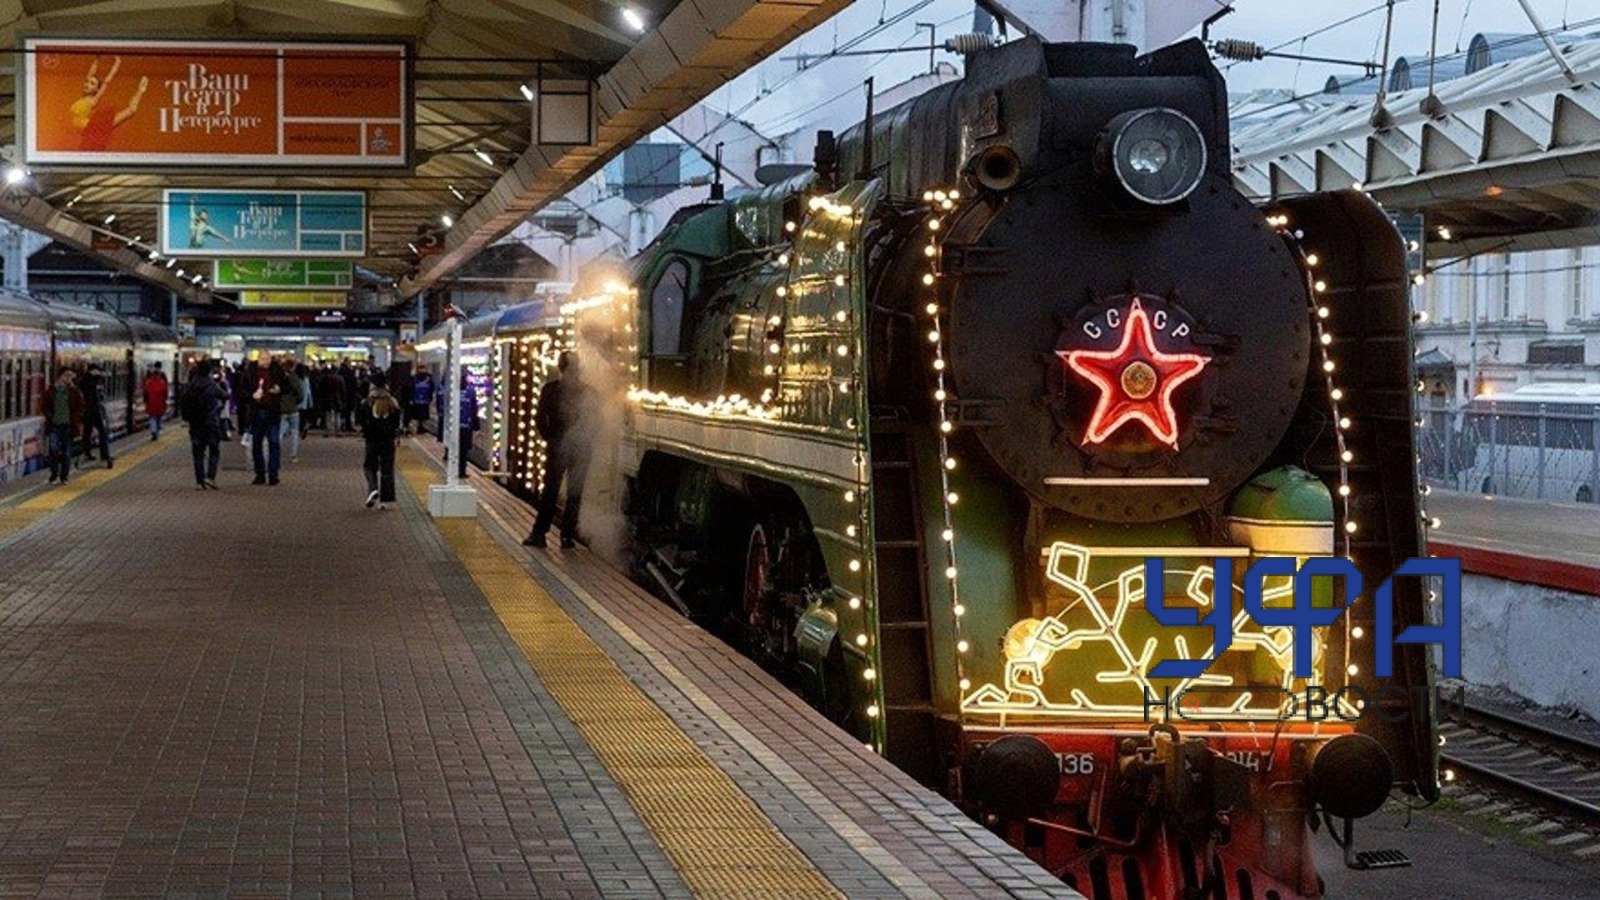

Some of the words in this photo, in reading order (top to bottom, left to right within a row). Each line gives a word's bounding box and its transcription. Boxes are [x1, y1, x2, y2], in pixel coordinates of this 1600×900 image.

[188, 63, 249, 90] Ваш
[164, 80, 241, 115] Театр
[1083, 308, 1190, 339] СССР
